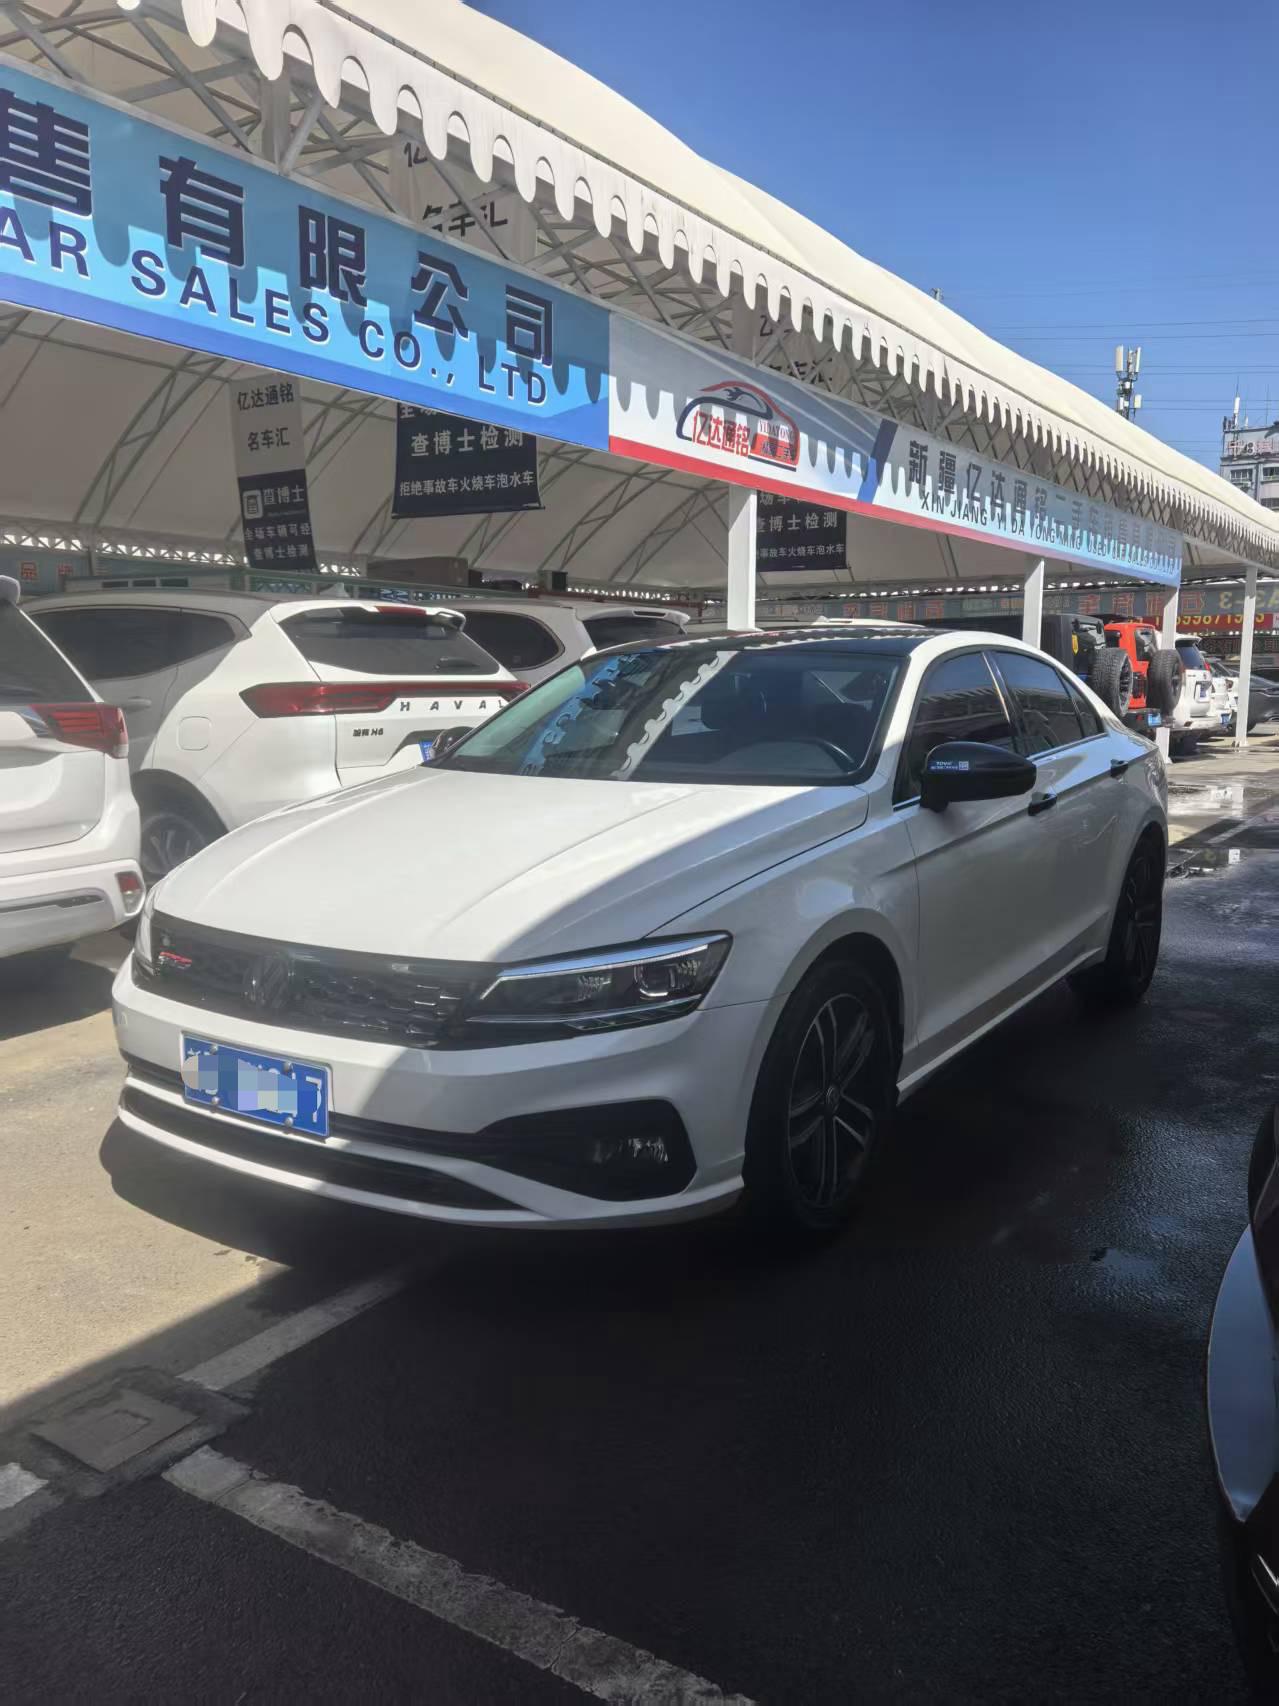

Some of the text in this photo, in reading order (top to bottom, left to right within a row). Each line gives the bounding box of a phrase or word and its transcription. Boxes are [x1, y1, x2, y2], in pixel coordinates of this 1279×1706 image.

[131, 250, 330, 343] SALES
[478, 355, 547, 404] LTD
[237, 383, 295, 411] 亿达通铭
[247, 427, 291, 451] 名车汇
[411, 425, 525, 457] 查博士检测
[692, 411, 750, 457] 亿达通铭
[400, 470, 534, 497] 拒绝事故车火烧车泡水车
[921, 492, 944, 514] XIN
[951, 499, 987, 526] JIANG
[1011, 519, 1025, 537] DA
